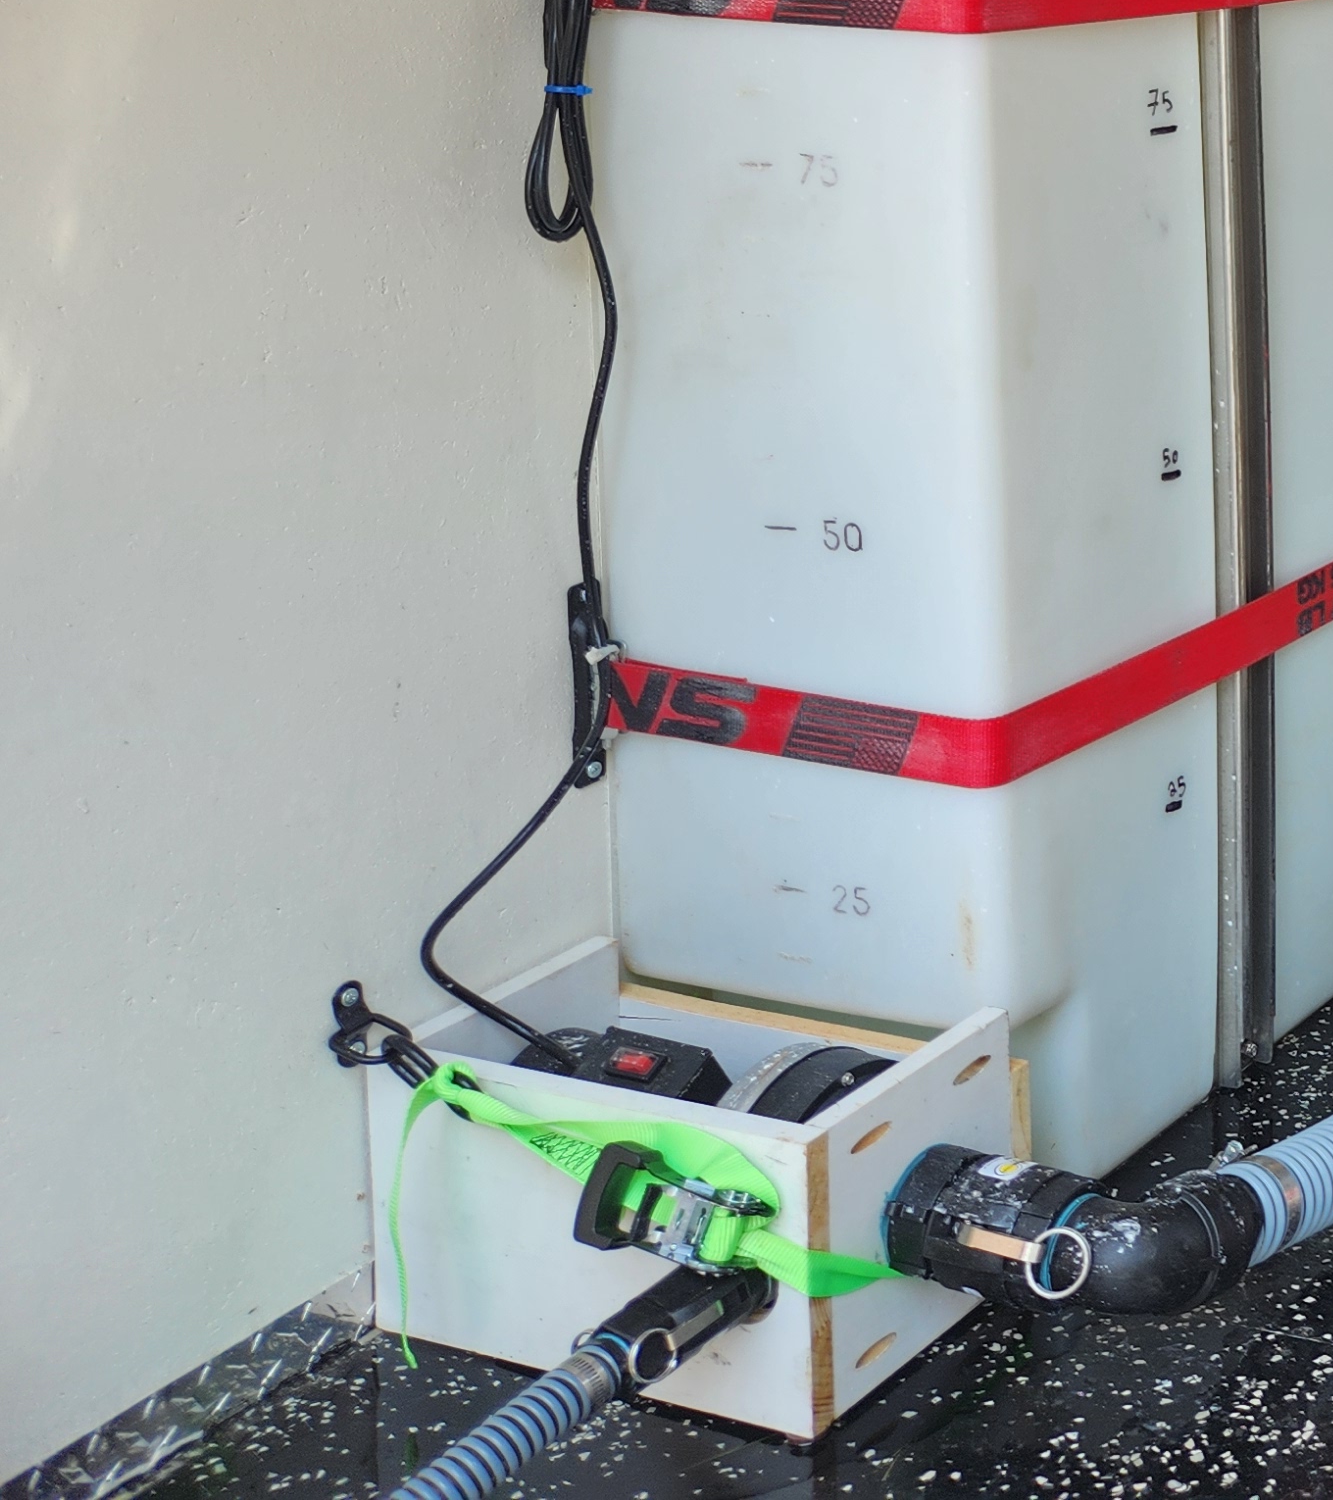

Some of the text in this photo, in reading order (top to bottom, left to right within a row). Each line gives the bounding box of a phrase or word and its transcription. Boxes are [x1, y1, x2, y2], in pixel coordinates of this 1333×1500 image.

[1147, 88, 1173, 116] 75
[798, 153, 839, 188] 75
[1162, 448, 1179, 468] 50
[822, 517, 864, 553] 50
[1168, 775, 1187, 798] 25
[832, 885, 871, 916] 25
